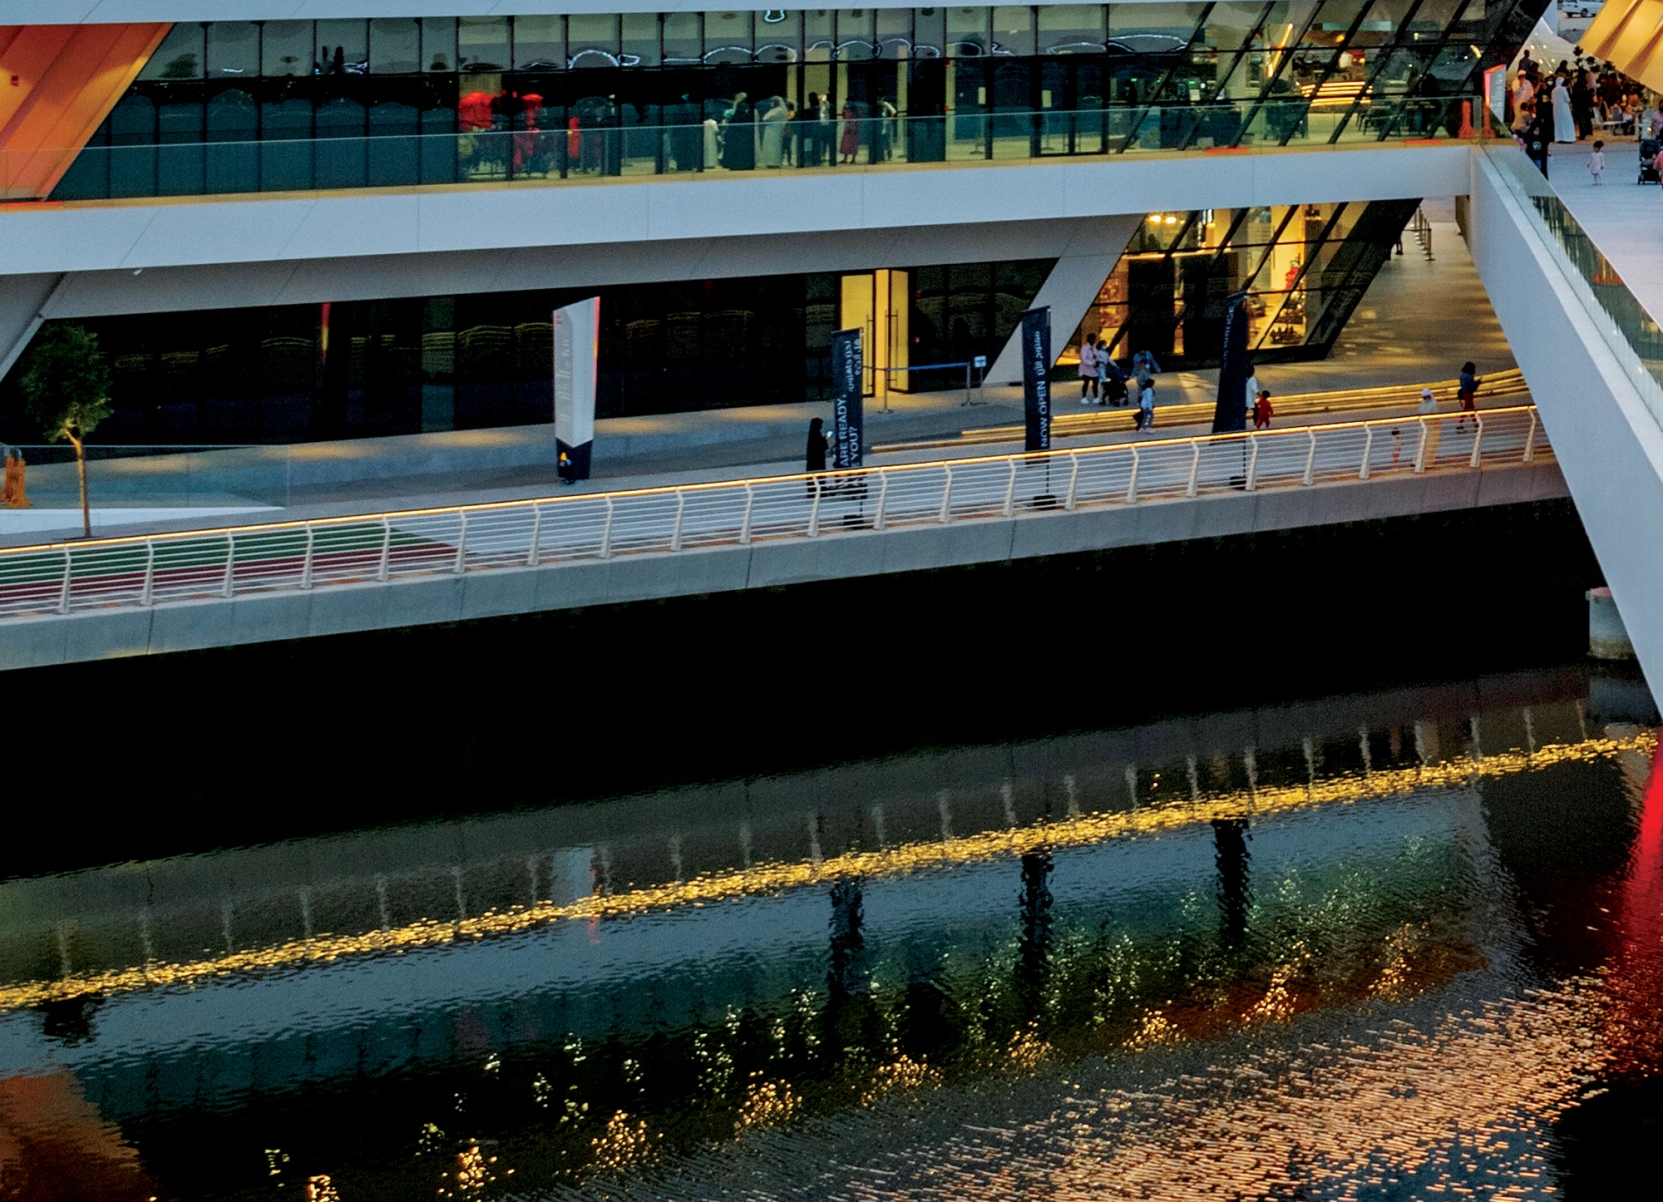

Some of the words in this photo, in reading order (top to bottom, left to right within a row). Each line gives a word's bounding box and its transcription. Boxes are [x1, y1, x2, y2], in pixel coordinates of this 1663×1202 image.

[1037, 380, 1047, 415] OPEN
[848, 426, 859, 461] YOU?
[1040, 417, 1048, 447] NOW
[839, 441, 850, 467] ARE
